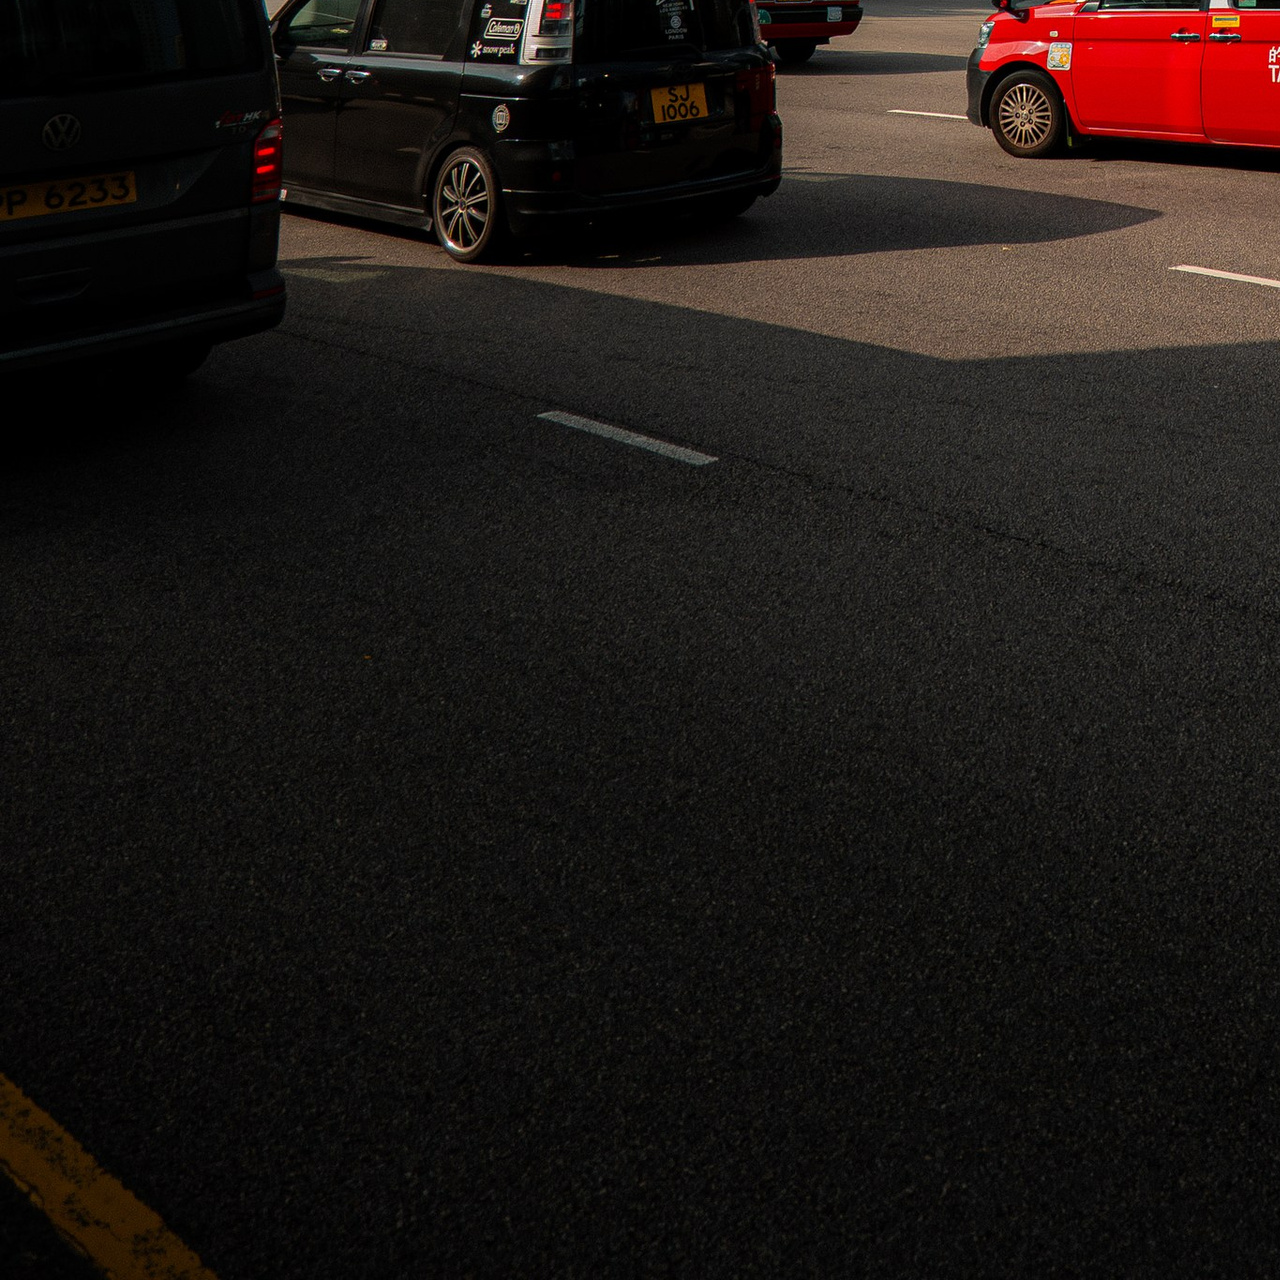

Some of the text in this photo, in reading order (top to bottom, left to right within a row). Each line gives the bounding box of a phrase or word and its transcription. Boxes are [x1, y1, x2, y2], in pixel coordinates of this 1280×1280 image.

[488, 21, 514, 34] Coleman
[668, 86, 690, 104] SJ
[661, 101, 700, 121] 1006
[0, 175, 130, 216] P 6233
